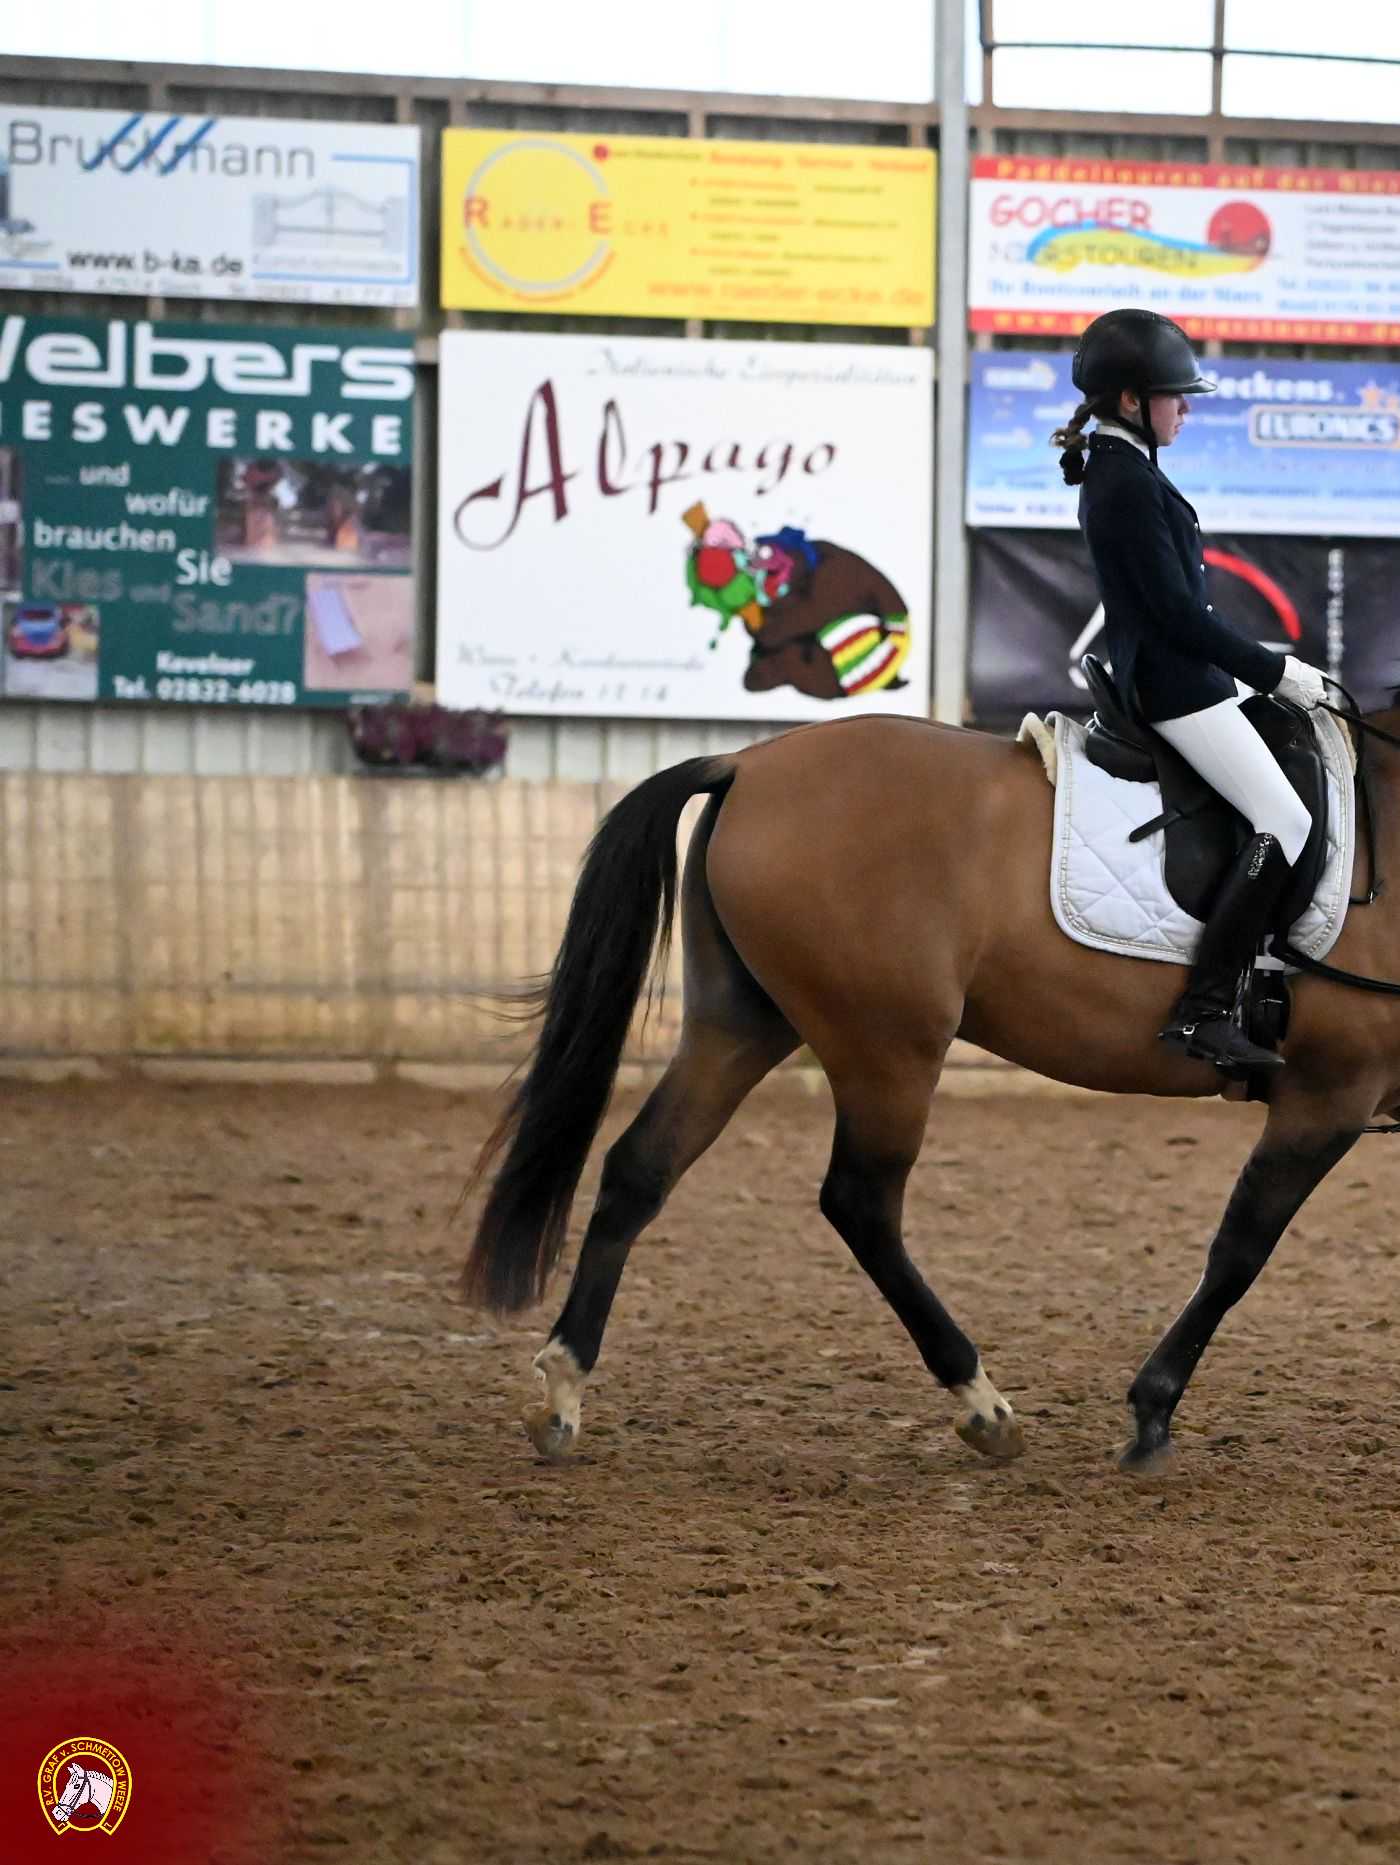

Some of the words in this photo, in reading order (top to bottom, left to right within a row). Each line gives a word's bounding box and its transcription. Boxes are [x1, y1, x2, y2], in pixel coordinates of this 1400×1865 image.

[990, 195, 1151, 229] GOCHER
[67, 250, 243, 276] www.b-ka.de
[0, 401, 402, 455] ESWERKE
[79, 462, 131, 487] und
[453, 378, 838, 551] Alpago
[125, 487, 208, 518] wofür
[33, 519, 177, 552] brauchen
[175, 549, 233, 587] Sie
[32, 558, 123, 600] Kies
[171, 592, 299, 636] Sand?
[113, 675, 151, 699] Tel.
